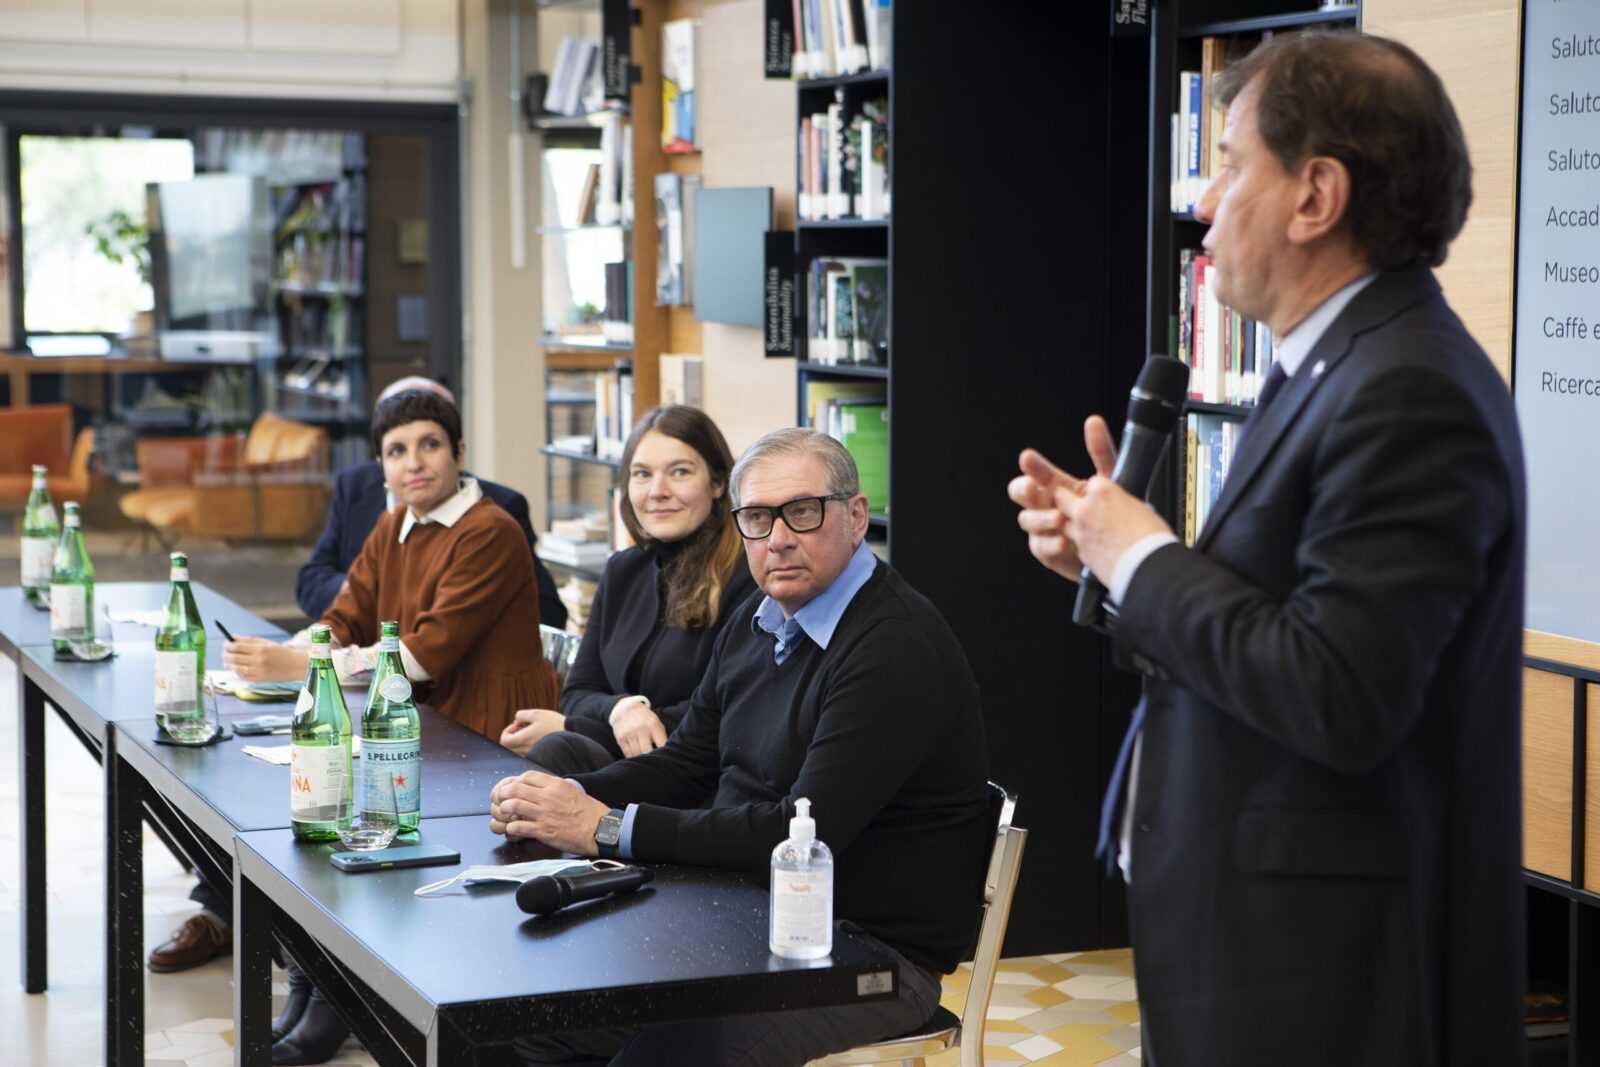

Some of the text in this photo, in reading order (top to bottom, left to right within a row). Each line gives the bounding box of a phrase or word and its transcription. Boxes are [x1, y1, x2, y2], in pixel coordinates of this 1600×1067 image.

[1549, 91, 1600, 115] Saluto
[1547, 147, 1600, 171] Saluto
[1546, 205, 1599, 227] Accad
[1544, 261, 1599, 283] Museo
[1543, 316, 1588, 339] Caffè
[1541, 371, 1600, 396] Ricerca
